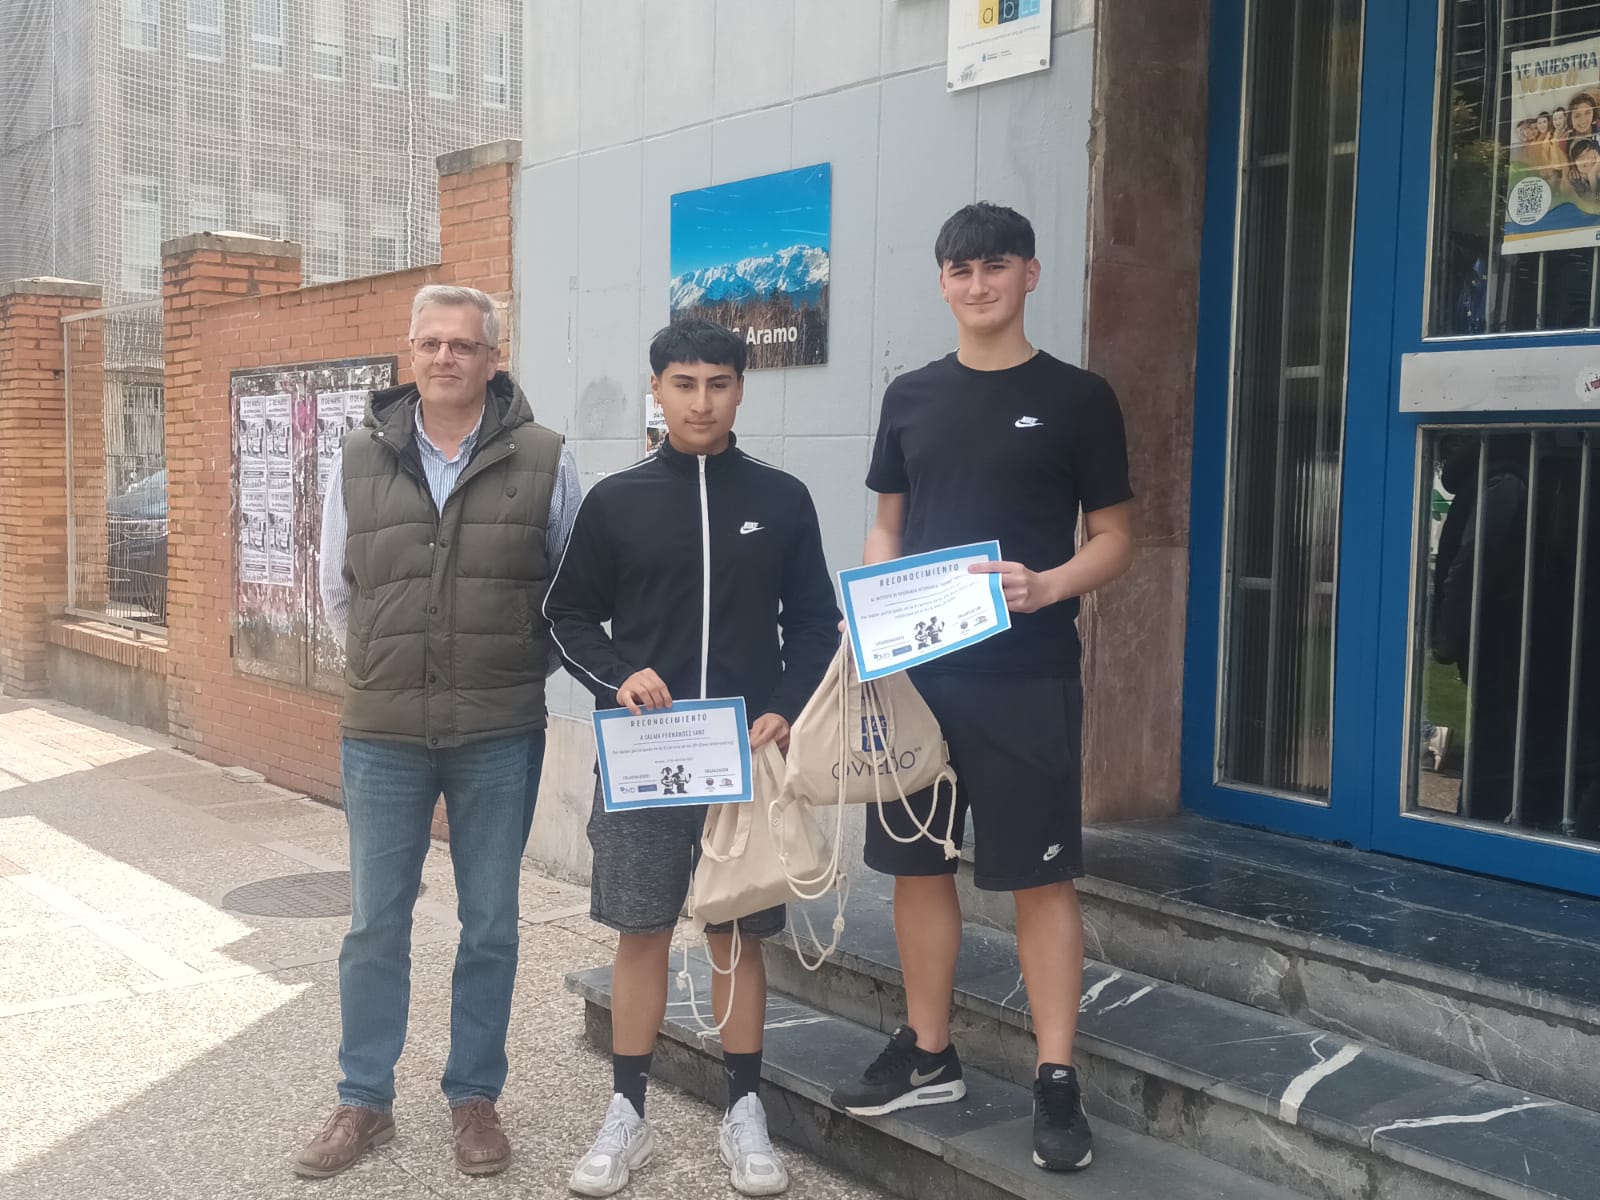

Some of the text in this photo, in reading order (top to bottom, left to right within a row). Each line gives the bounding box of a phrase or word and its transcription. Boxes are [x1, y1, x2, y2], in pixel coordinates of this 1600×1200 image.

[1534, 51, 1598, 77] NUESTRA
[746, 327, 798, 344] Aramo
[879, 563, 960, 587] RECONOCIMIENTO
[630, 713, 708, 727] RECONOCIMIENTO
